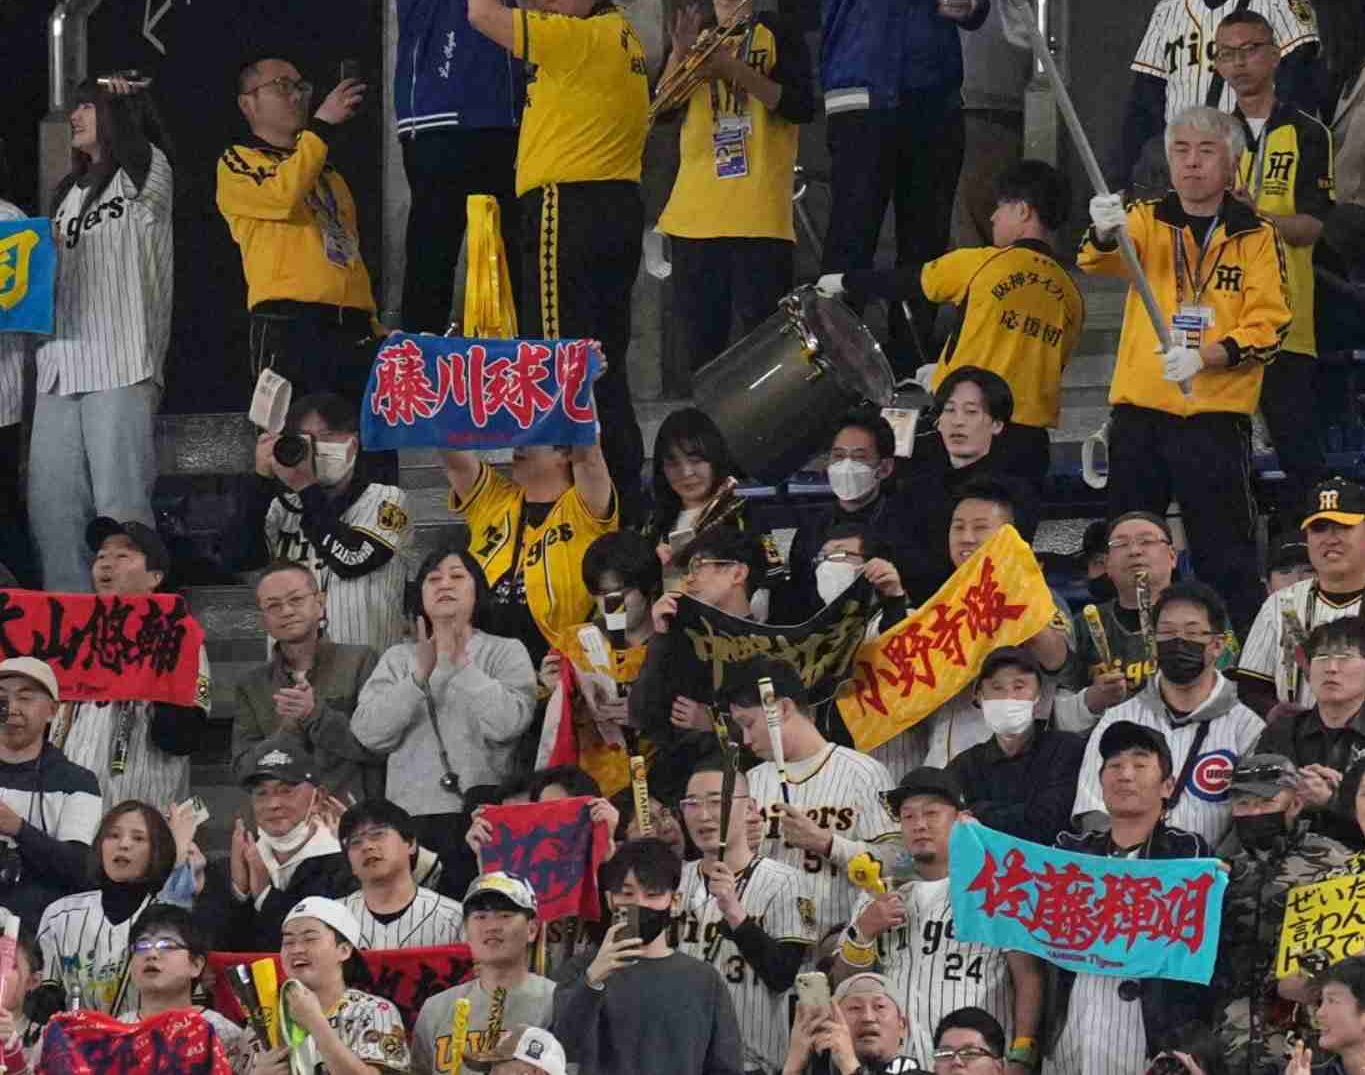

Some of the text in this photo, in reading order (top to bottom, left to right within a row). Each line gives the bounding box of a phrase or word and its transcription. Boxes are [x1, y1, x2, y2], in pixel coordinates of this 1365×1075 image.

[966, 846, 1215, 955] 佐藤輝明
[944, 953, 983, 982] 24
